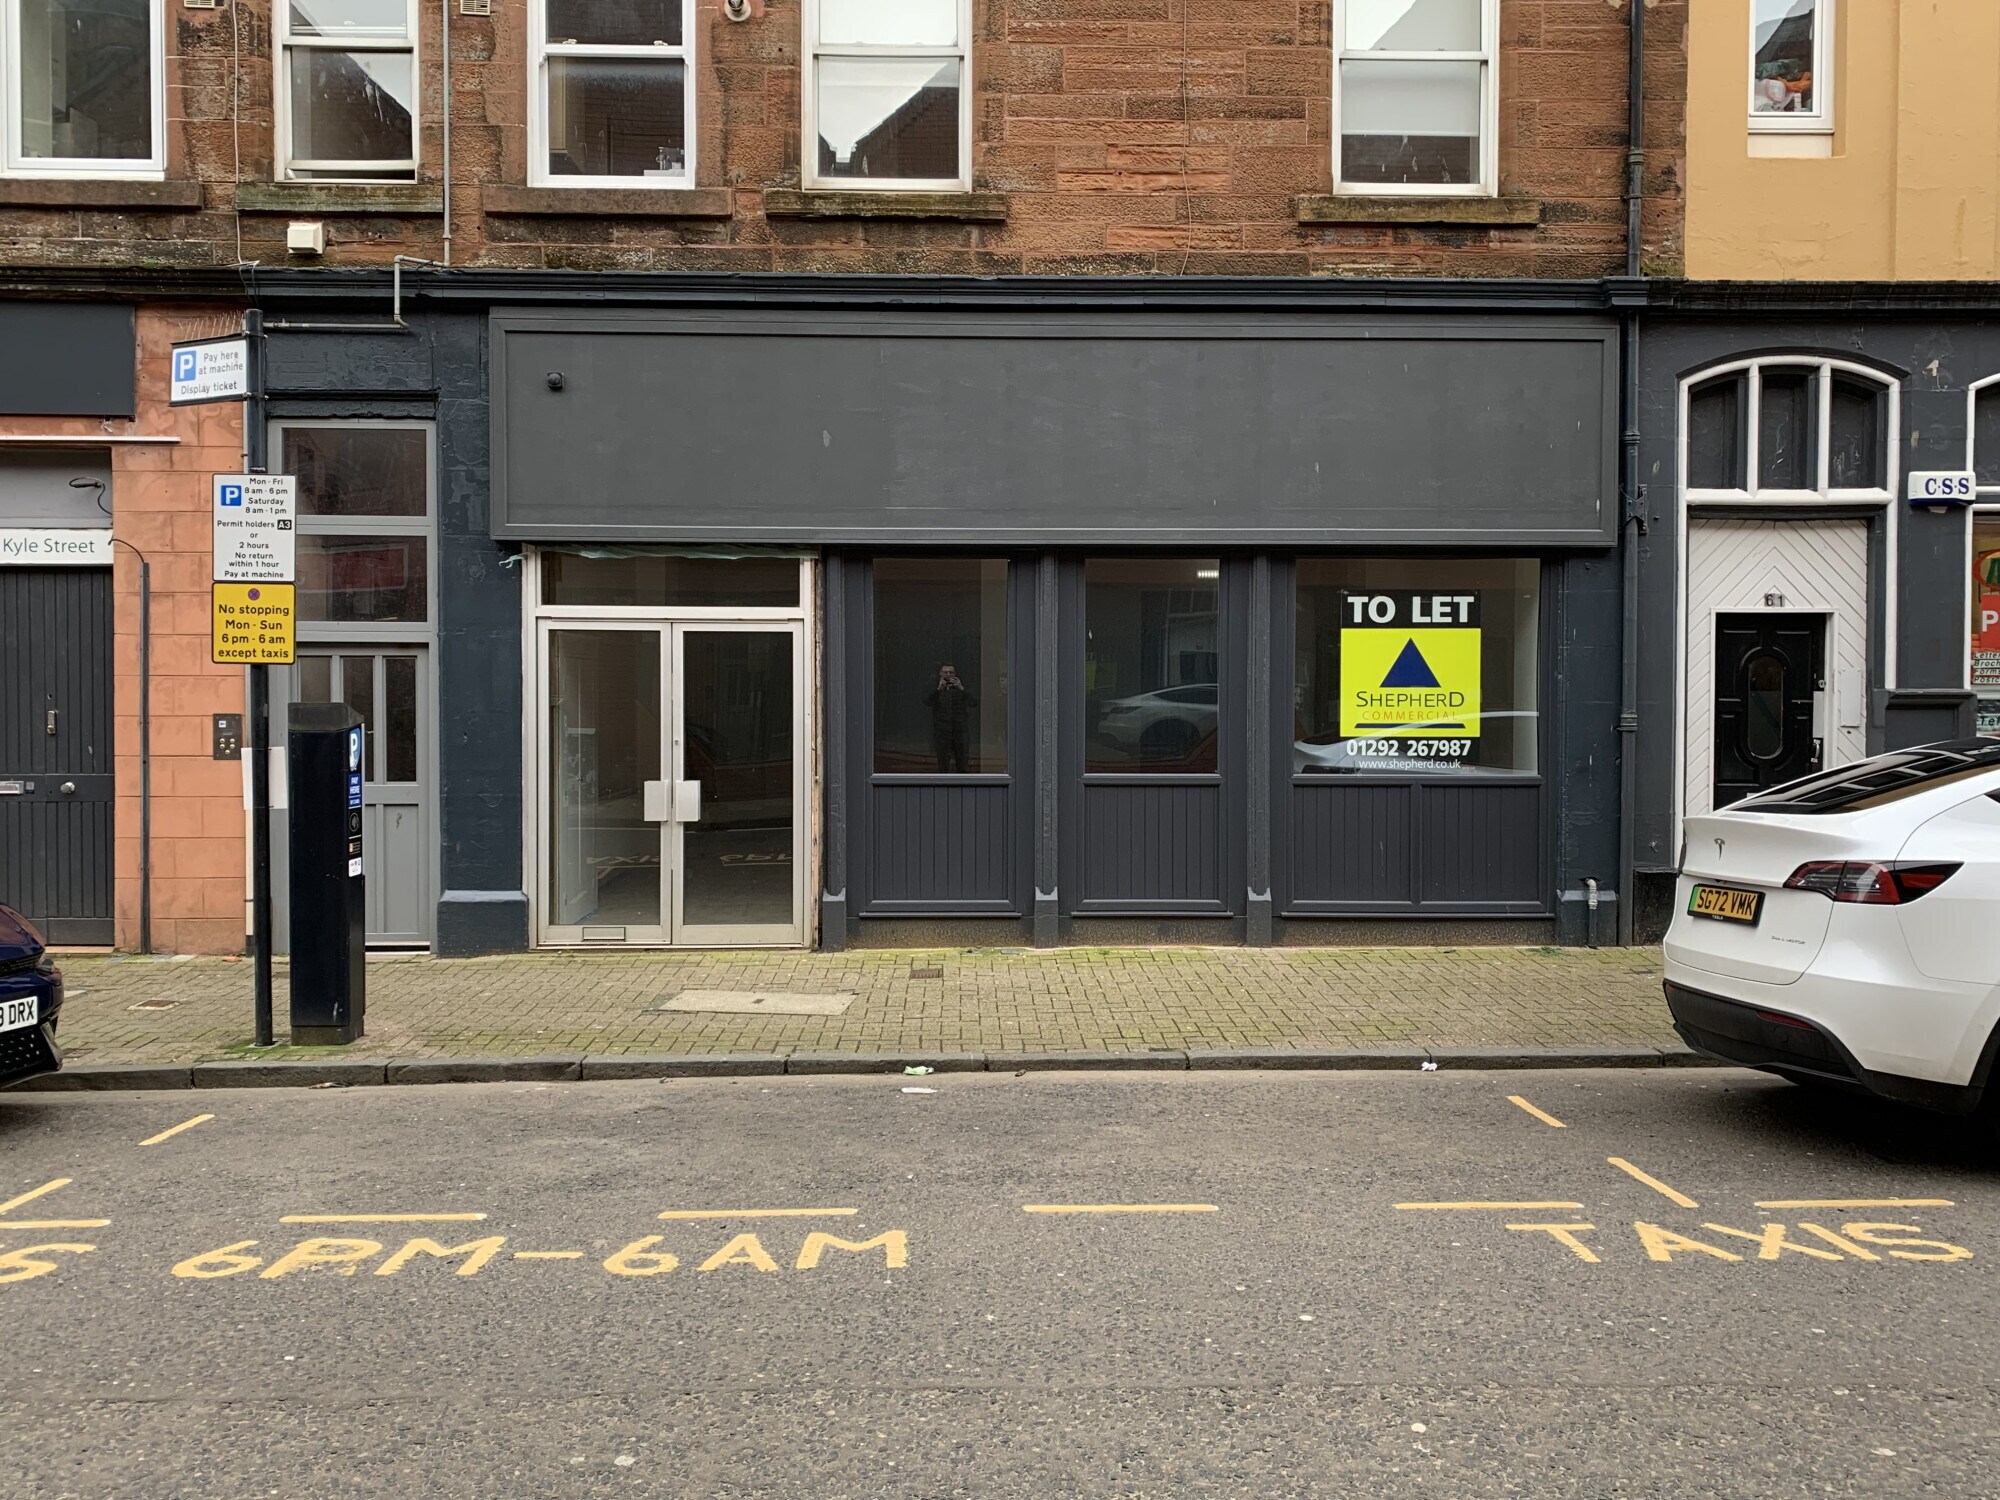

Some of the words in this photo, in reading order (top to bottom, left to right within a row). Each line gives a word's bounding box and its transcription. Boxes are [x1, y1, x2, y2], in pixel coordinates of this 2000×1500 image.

[203, 353, 218, 364] Pay
[221, 351, 239, 361] here
[199, 366, 207, 375] at
[209, 362, 243, 374] machine
[181, 384, 210, 395] Display
[213, 381, 237, 392] ticket
[248, 498, 284, 506] Saturday
[278, 520, 290, 528] A3
[3, 538, 38, 556] Kyle
[43, 538, 95, 553] Street
[225, 571, 238, 579] Pay
[1766, 594, 1784, 607] 61
[218, 603, 235, 613] No
[239, 604, 289, 615] stopping
[1347, 596, 1396, 624] TO
[1412, 596, 1475, 624] LET
[225, 620, 250, 629] Mon
[260, 620, 282, 630] Sun
[222, 634, 229, 643] 6
[232, 635, 249, 644] pm
[258, 634, 266, 643] 6
[268, 635, 285, 643] am
[218, 648, 256, 658] except
[261, 648, 288, 657] taxis
[1362, 711, 1457, 721] COMMERCIAL
[1346, 740, 1399, 757] 01292
[1407, 740, 1471, 757] 267987
[1358, 759, 1461, 770] www.shepherd.co.uk
[1697, 888, 1729, 912] SG72
[1730, 892, 1756, 916] VMK
[8, 1000, 35, 1025] DRX
[1505, 1220, 1974, 1263] TAXIS
